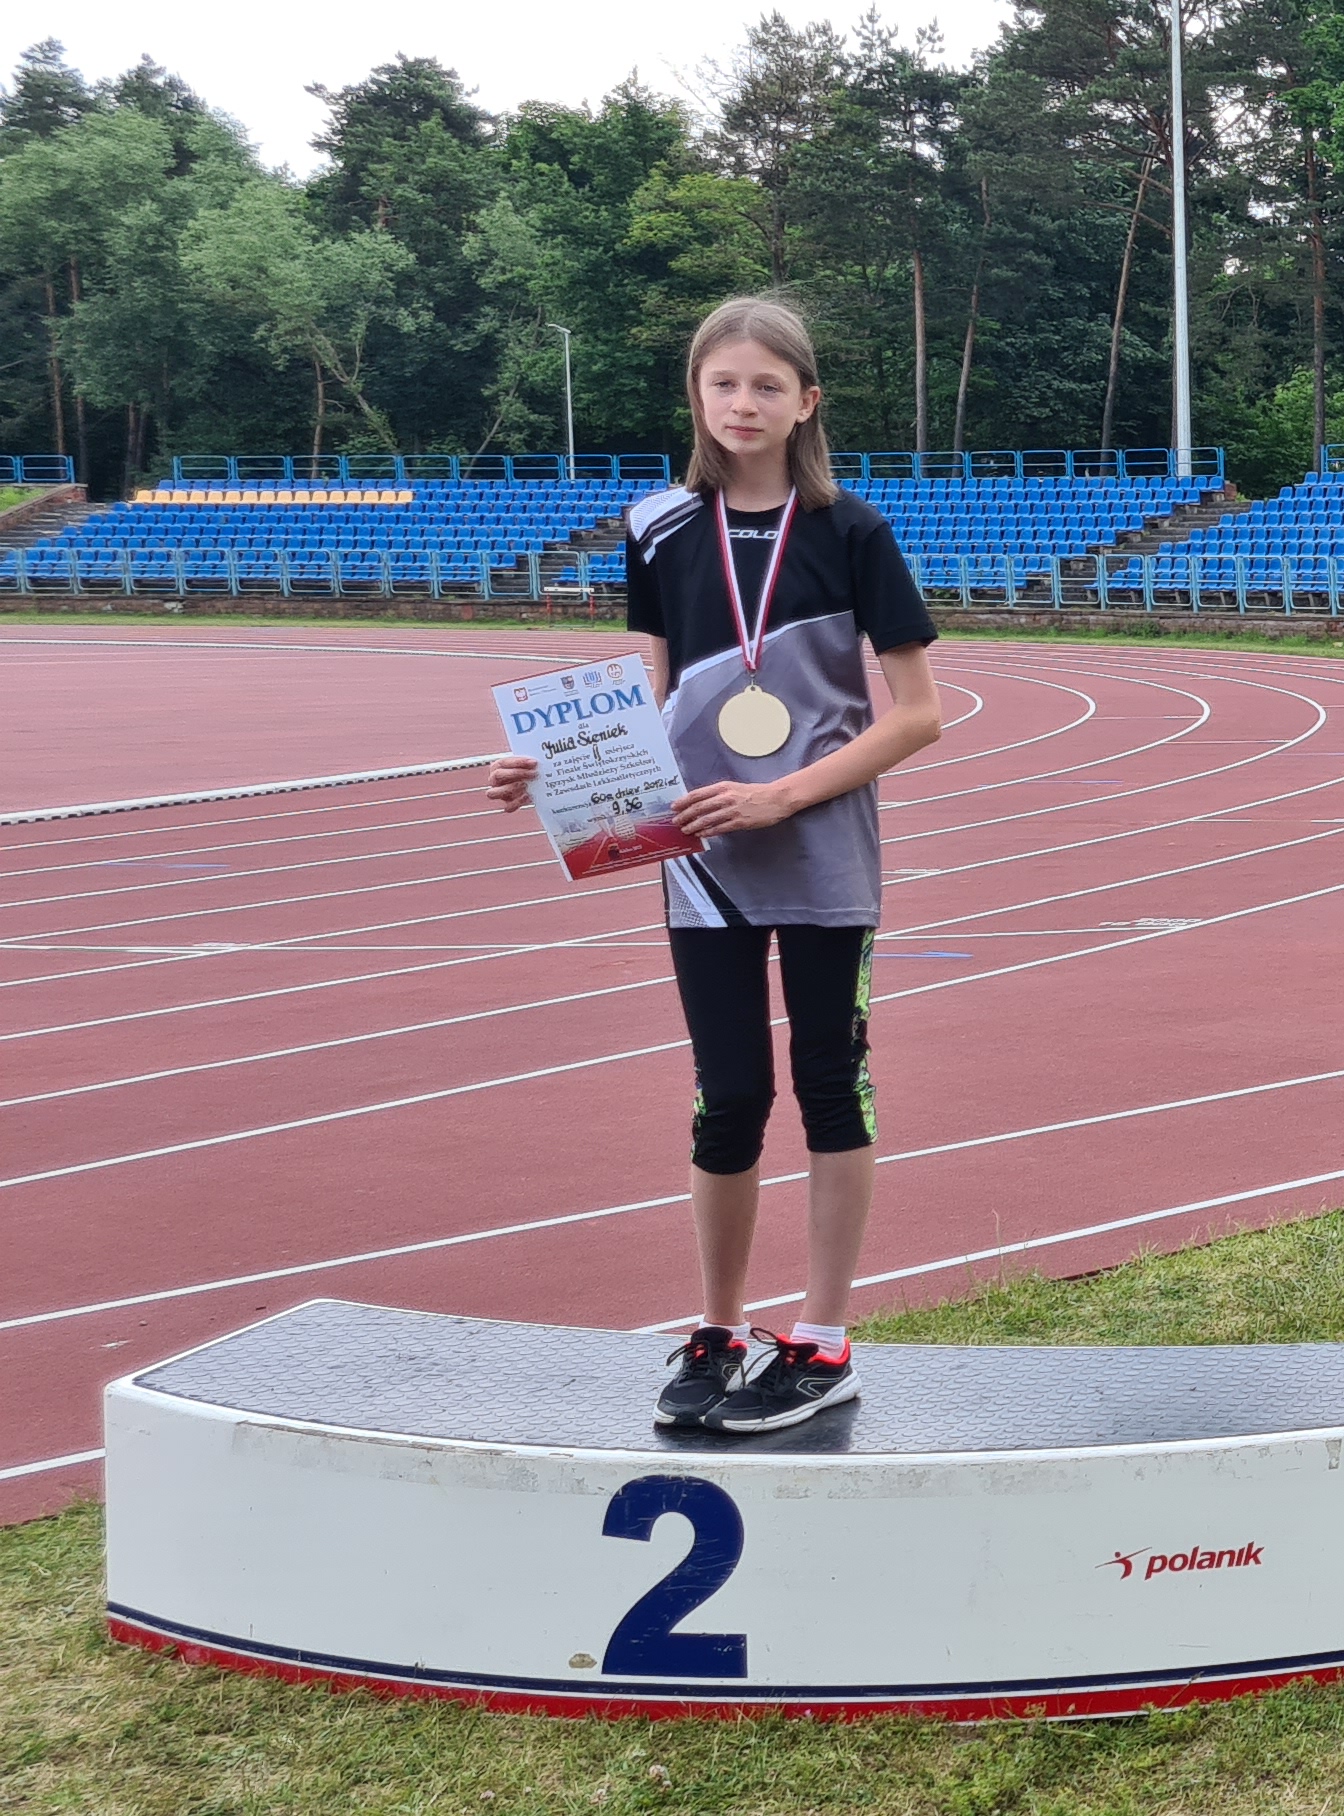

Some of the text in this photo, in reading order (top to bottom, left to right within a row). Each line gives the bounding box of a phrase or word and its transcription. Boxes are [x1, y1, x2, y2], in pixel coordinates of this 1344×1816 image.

[511, 684, 647, 735] DYPLOM
[612, 797, 643, 815] 9,36
[601, 1474, 748, 1679] 2
[1144, 1541, 1265, 1581] polanik
